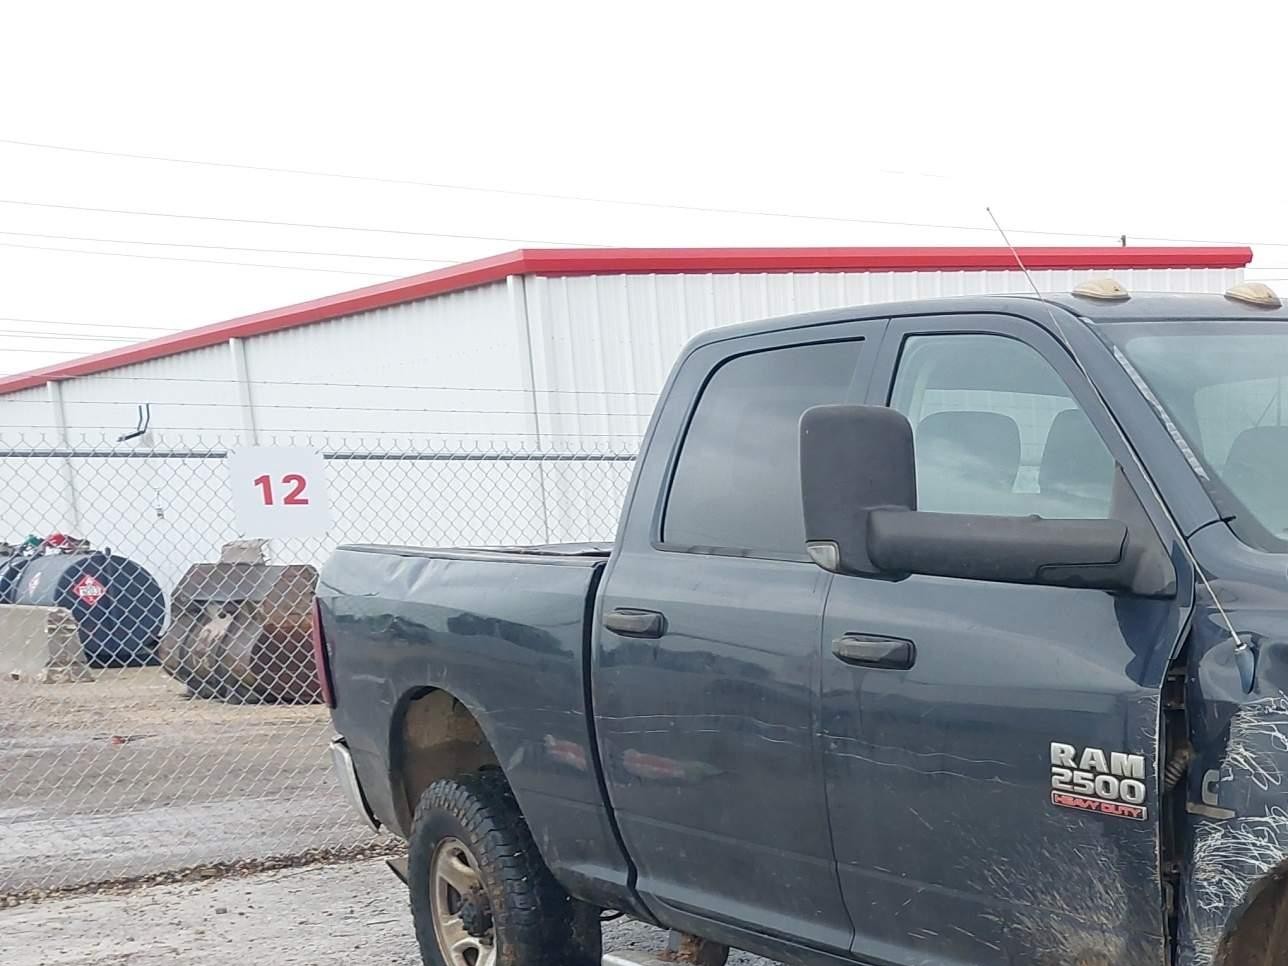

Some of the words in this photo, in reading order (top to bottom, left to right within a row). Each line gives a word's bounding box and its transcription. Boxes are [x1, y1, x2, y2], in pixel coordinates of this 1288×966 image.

[254, 474, 309, 505] 12
[1050, 742, 1145, 779] RAM
[1051, 766, 1146, 804] 2500
[1054, 794, 1100, 810] HEAVY
[1101, 802, 1143, 817] DUTY
